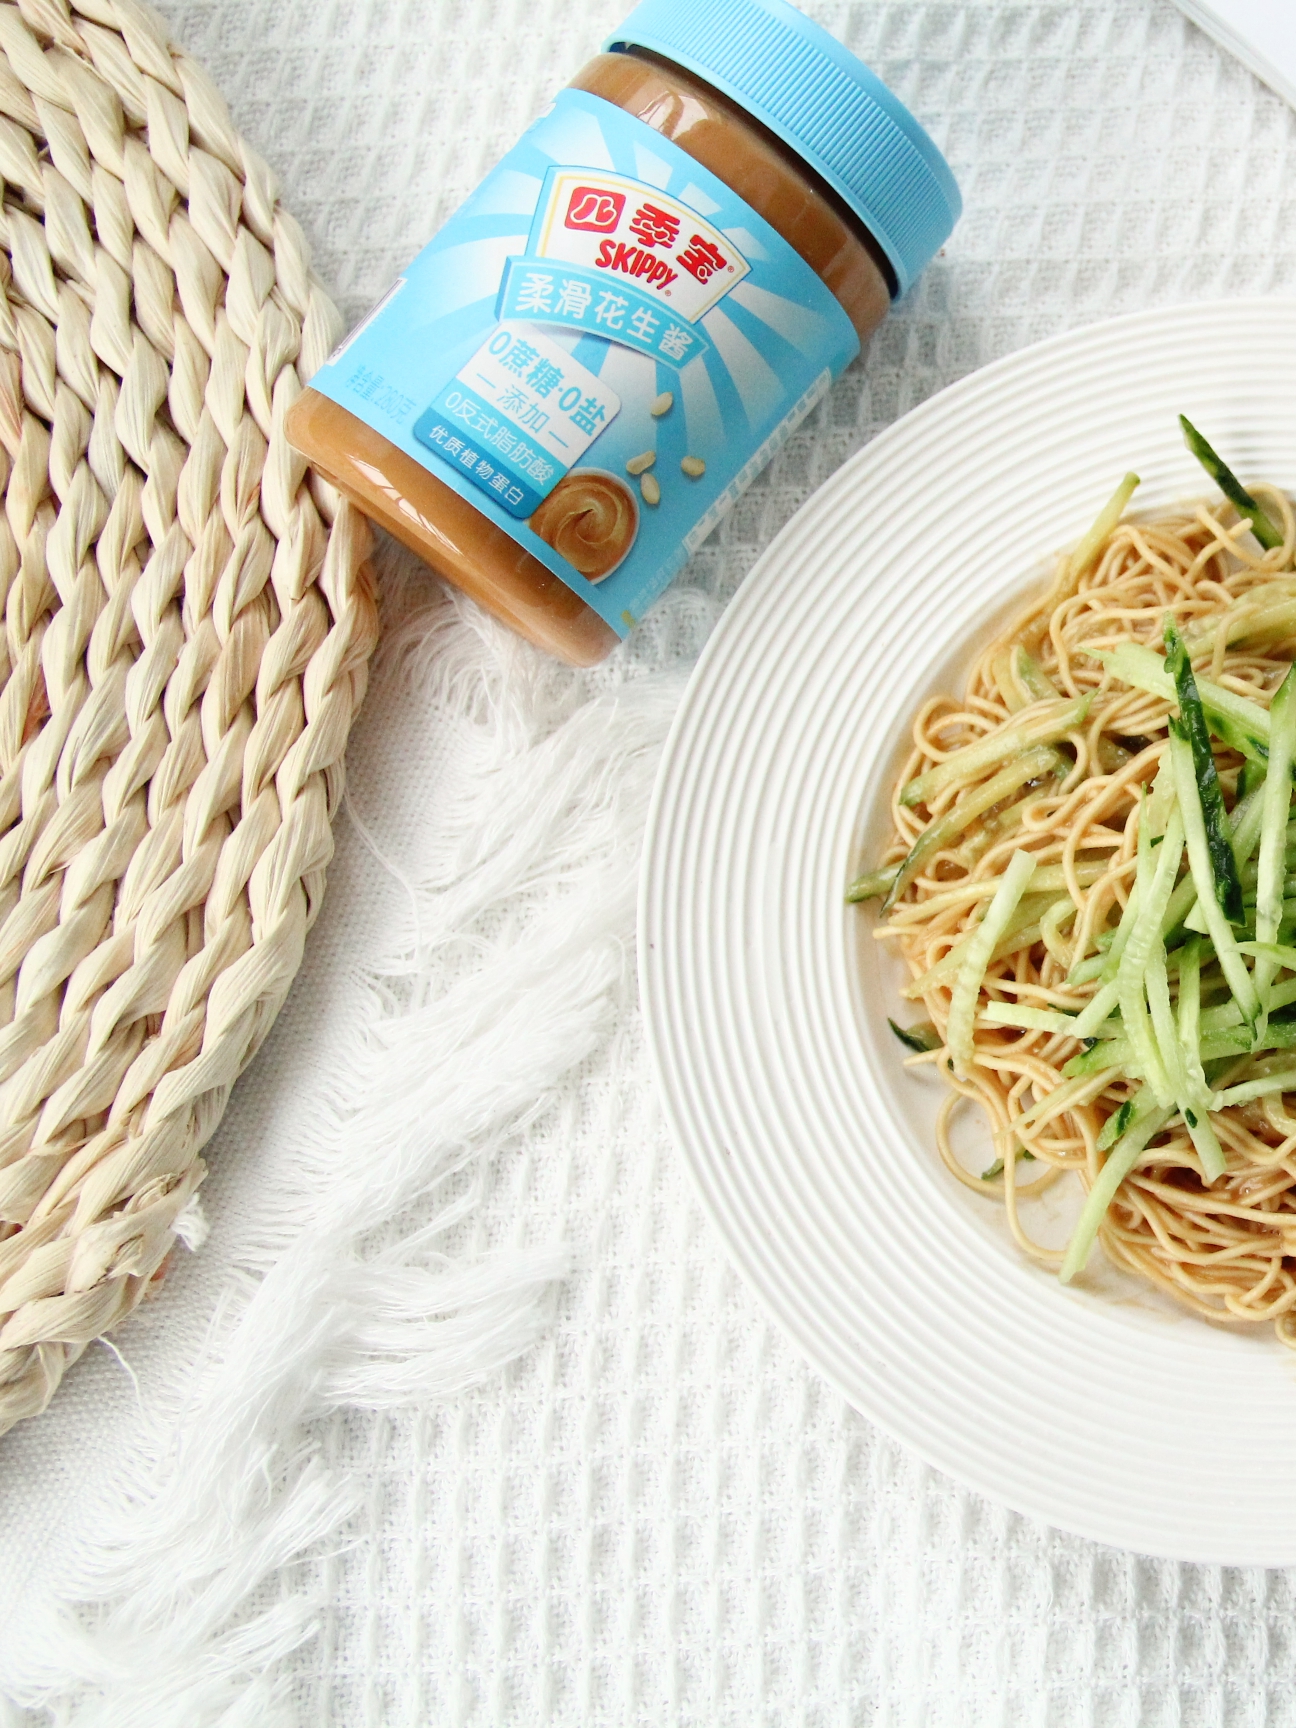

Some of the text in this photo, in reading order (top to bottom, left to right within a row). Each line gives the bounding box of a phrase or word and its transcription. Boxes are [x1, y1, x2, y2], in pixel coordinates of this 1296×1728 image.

[595, 239, 678, 290] SKIPPY
[515, 273, 694, 361] 柔滑花生酱
[429, 424, 525, 506] 优质植物蛋白
[445, 391, 555, 486] 0反式脂肪酸
